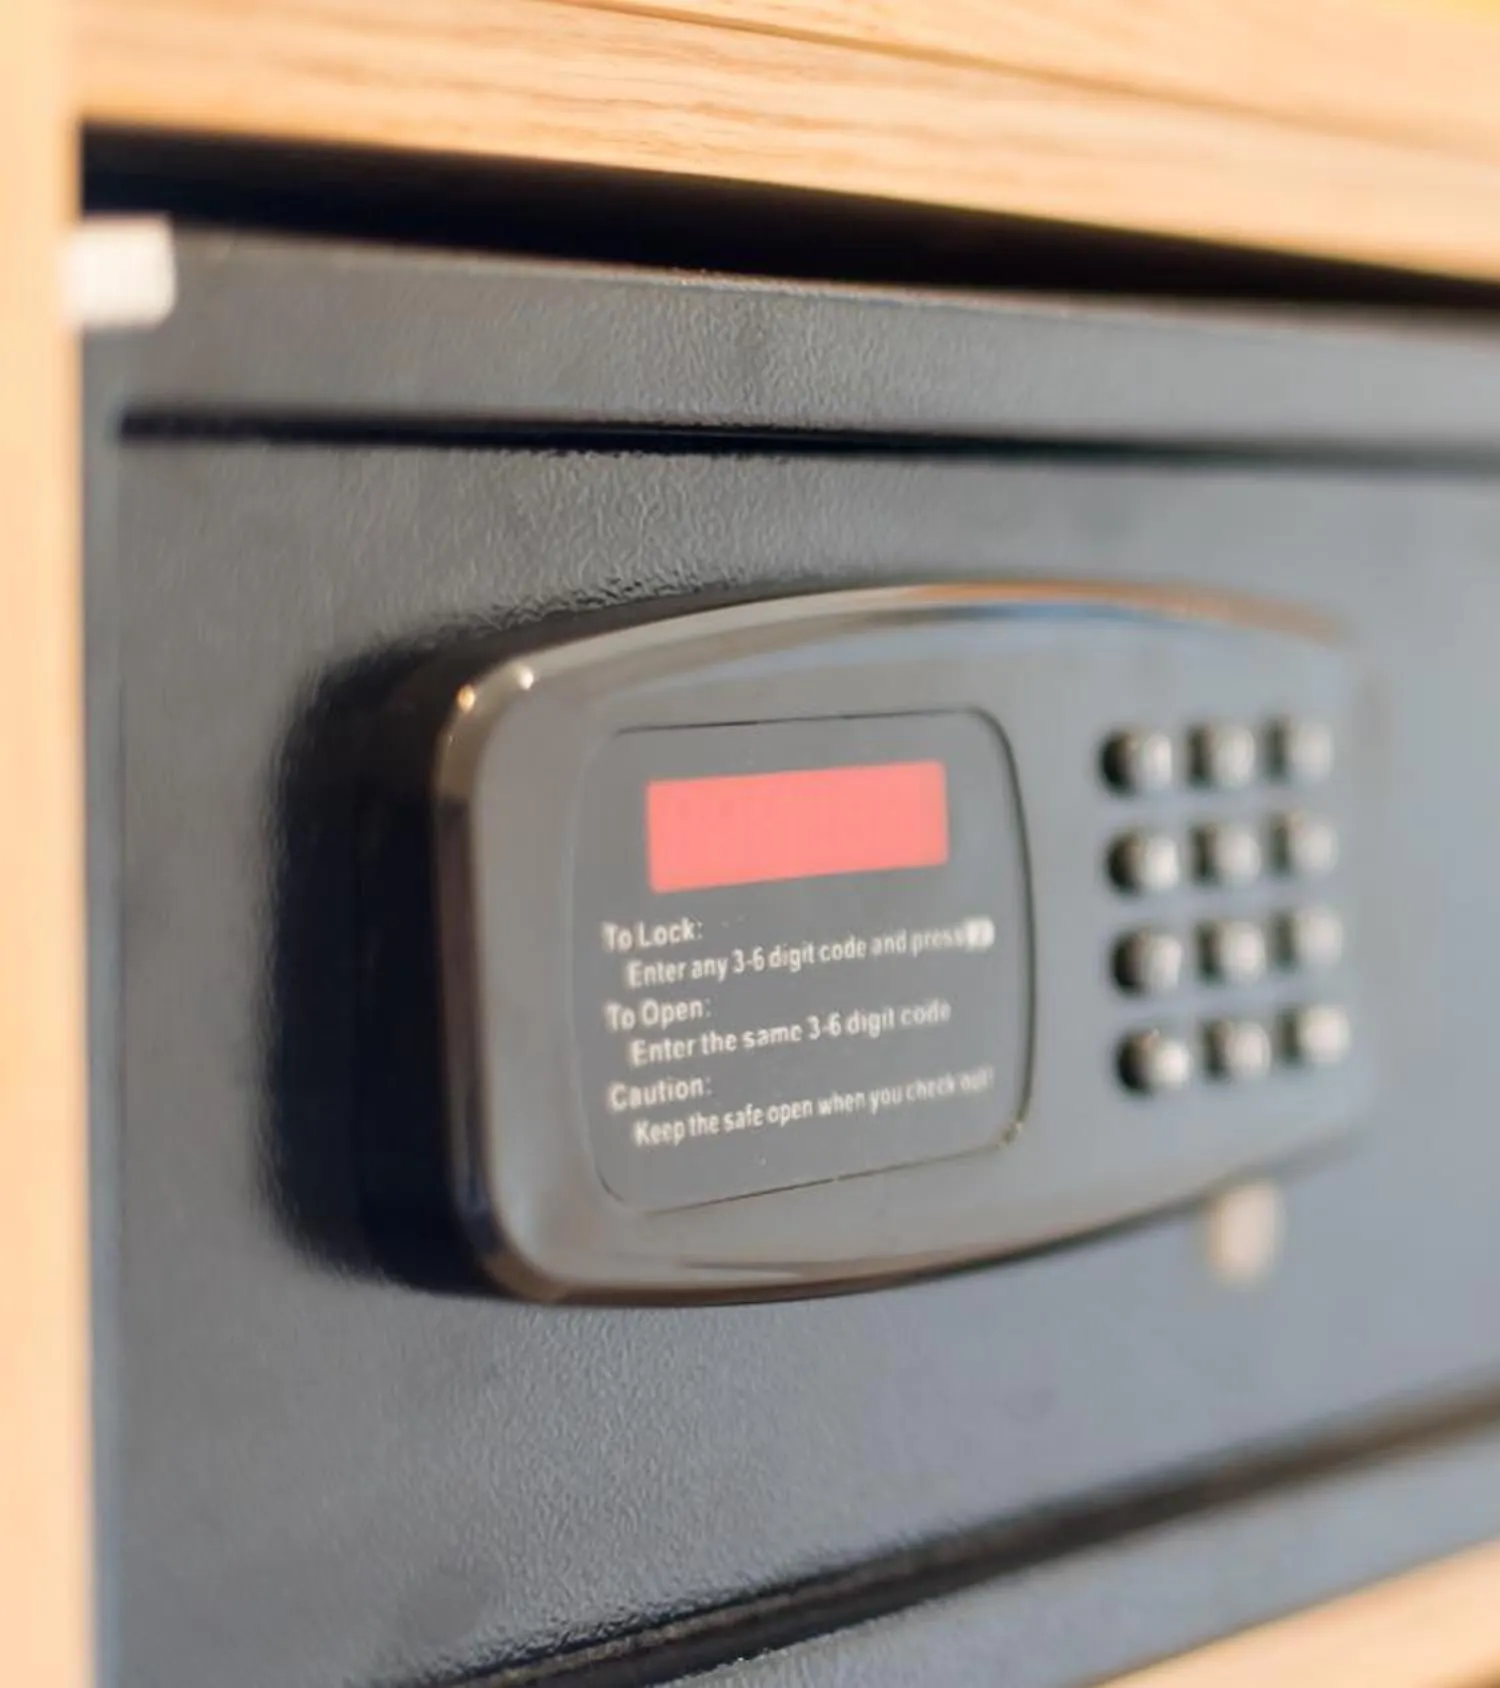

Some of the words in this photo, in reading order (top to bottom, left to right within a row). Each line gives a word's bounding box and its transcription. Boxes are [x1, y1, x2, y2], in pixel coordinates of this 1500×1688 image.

[601, 921, 633, 952] To
[638, 917, 704, 947] Lock:
[625, 958, 686, 988] Enter
[691, 954, 728, 982] any
[732, 946, 765, 974] 3-6
[769, 941, 815, 972] digit
[818, 935, 866, 962] code
[871, 928, 907, 955] and
[605, 1003, 636, 1031] To
[641, 998, 712, 1031] Open:
[629, 1038, 693, 1066] Enter
[700, 1028, 737, 1055] the
[742, 1024, 802, 1049] same
[808, 1015, 842, 1040] 3-6
[846, 1009, 896, 1038] digit
[900, 999, 951, 1025] code
[608, 1076, 713, 1110] Caution:
[633, 1119, 685, 1146] Keep
[688, 1109, 719, 1135] the
[723, 1103, 763, 1131] safe
[768, 1093, 814, 1126] open
[817, 1089, 866, 1118] when
[869, 1086, 903, 1113] you
[905, 1071, 955, 1101] check
